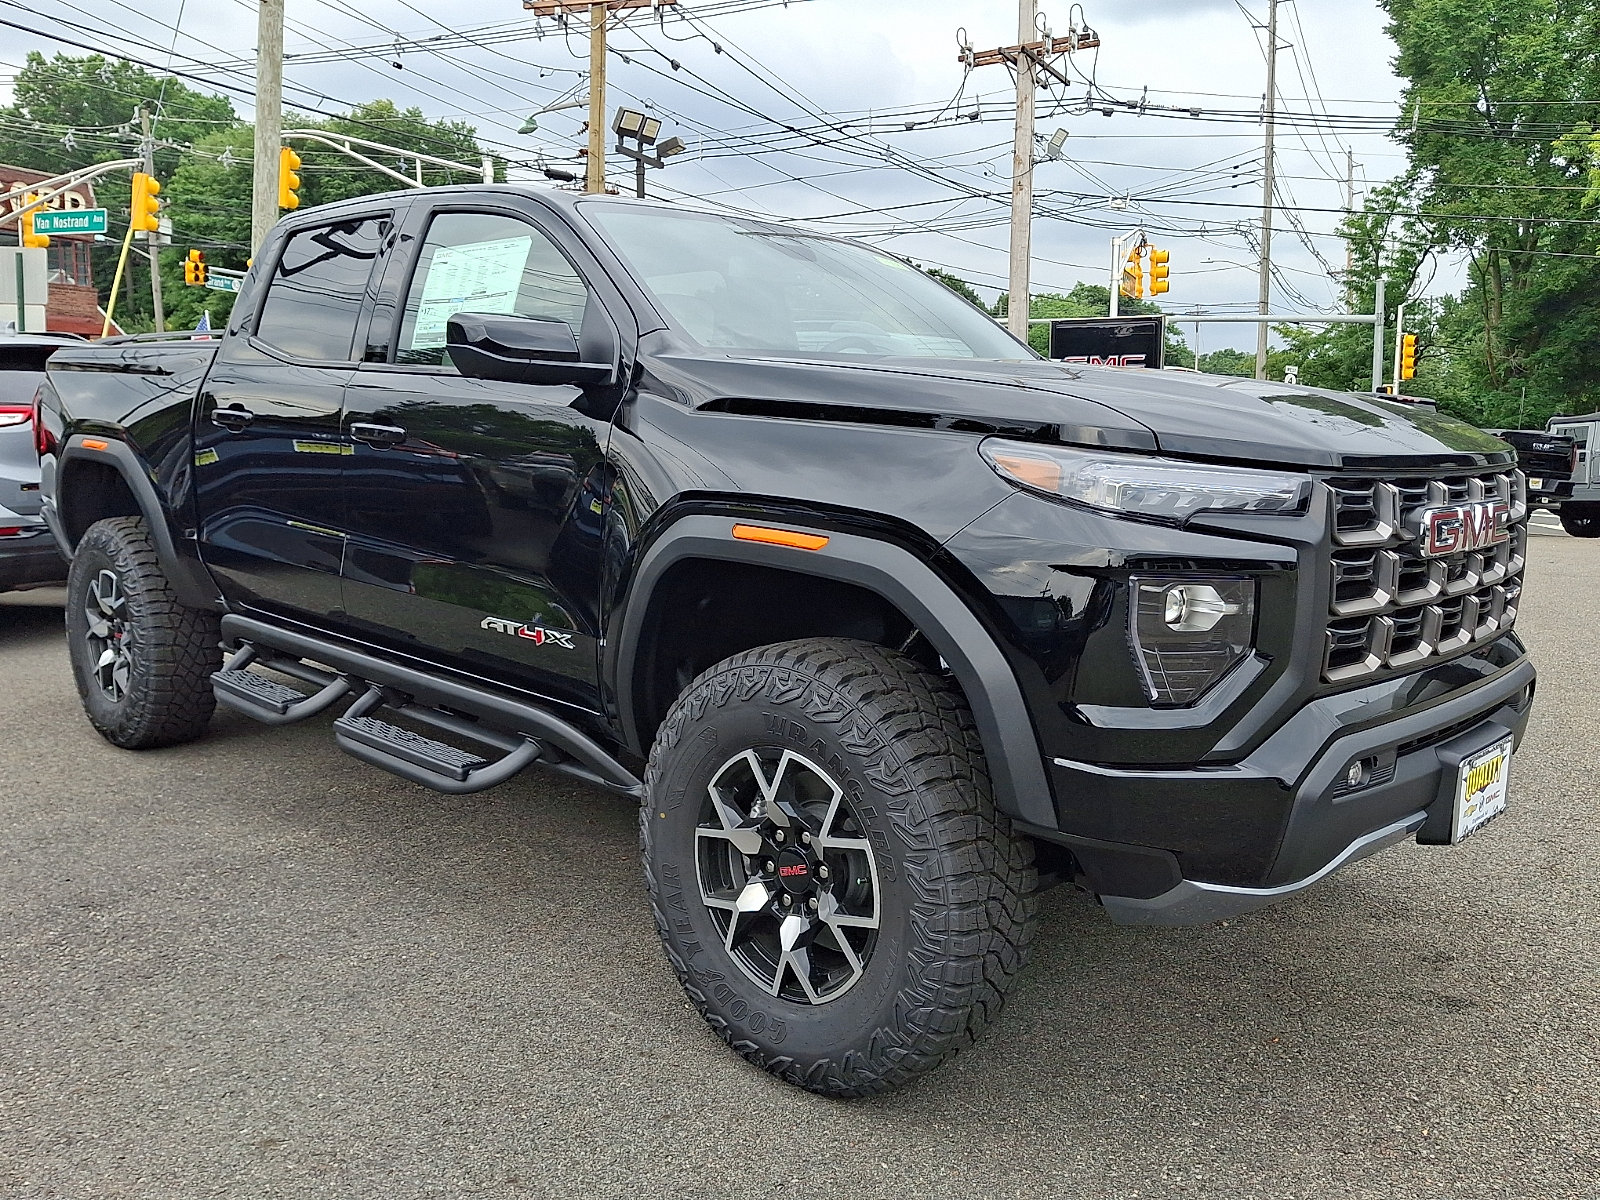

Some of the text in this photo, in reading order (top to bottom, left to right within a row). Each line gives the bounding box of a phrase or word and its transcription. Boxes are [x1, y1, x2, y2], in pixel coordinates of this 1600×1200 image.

[0, 180, 86, 213] ORD
[36, 214, 103, 229] Van Nostrand Ave
[1427, 503, 1509, 555] GMC
[480, 616, 576, 650] AT4X
[1465, 755, 1505, 803] QUALITY
[761, 711, 897, 882] WRANGLER
[1486, 790, 1500, 804] GMC
[779, 864, 808, 877] GMC
